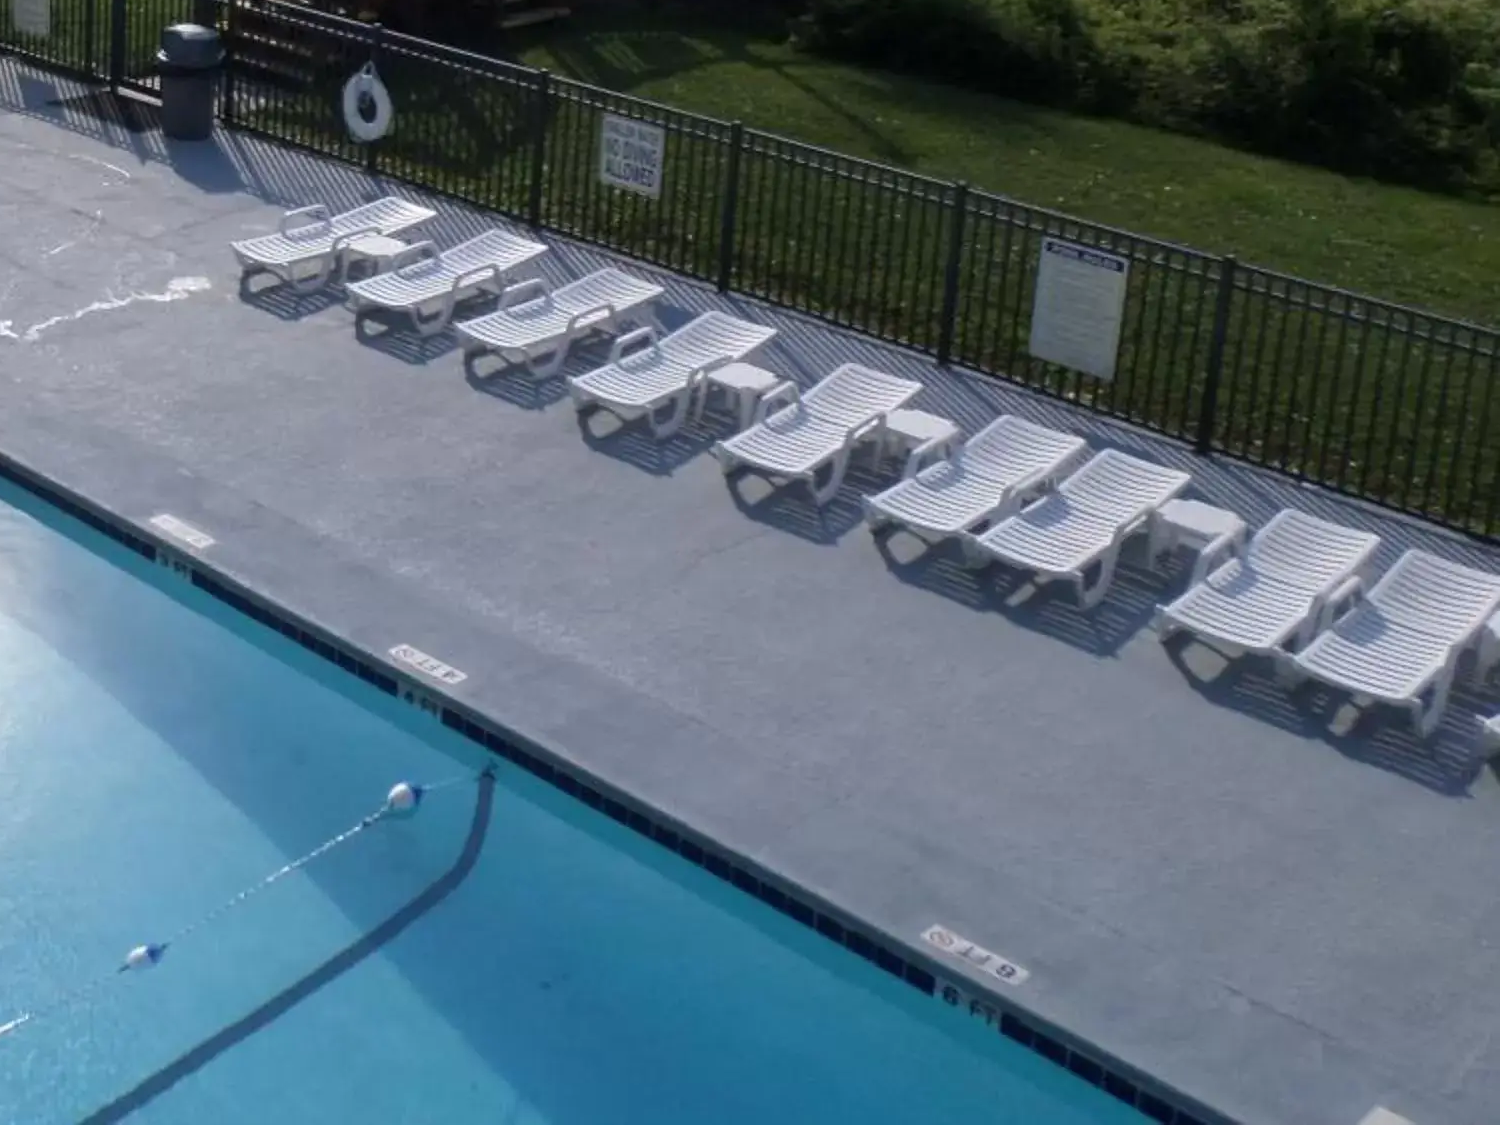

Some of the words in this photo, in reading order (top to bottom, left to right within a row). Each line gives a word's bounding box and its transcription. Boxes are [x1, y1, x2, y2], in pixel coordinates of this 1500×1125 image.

[622, 141, 657, 167] DIVING
[604, 158, 655, 188] ALLOWED
[957, 946, 992, 966] FT
[995, 964, 1017, 978] 6
[968, 999, 999, 1027] FT
